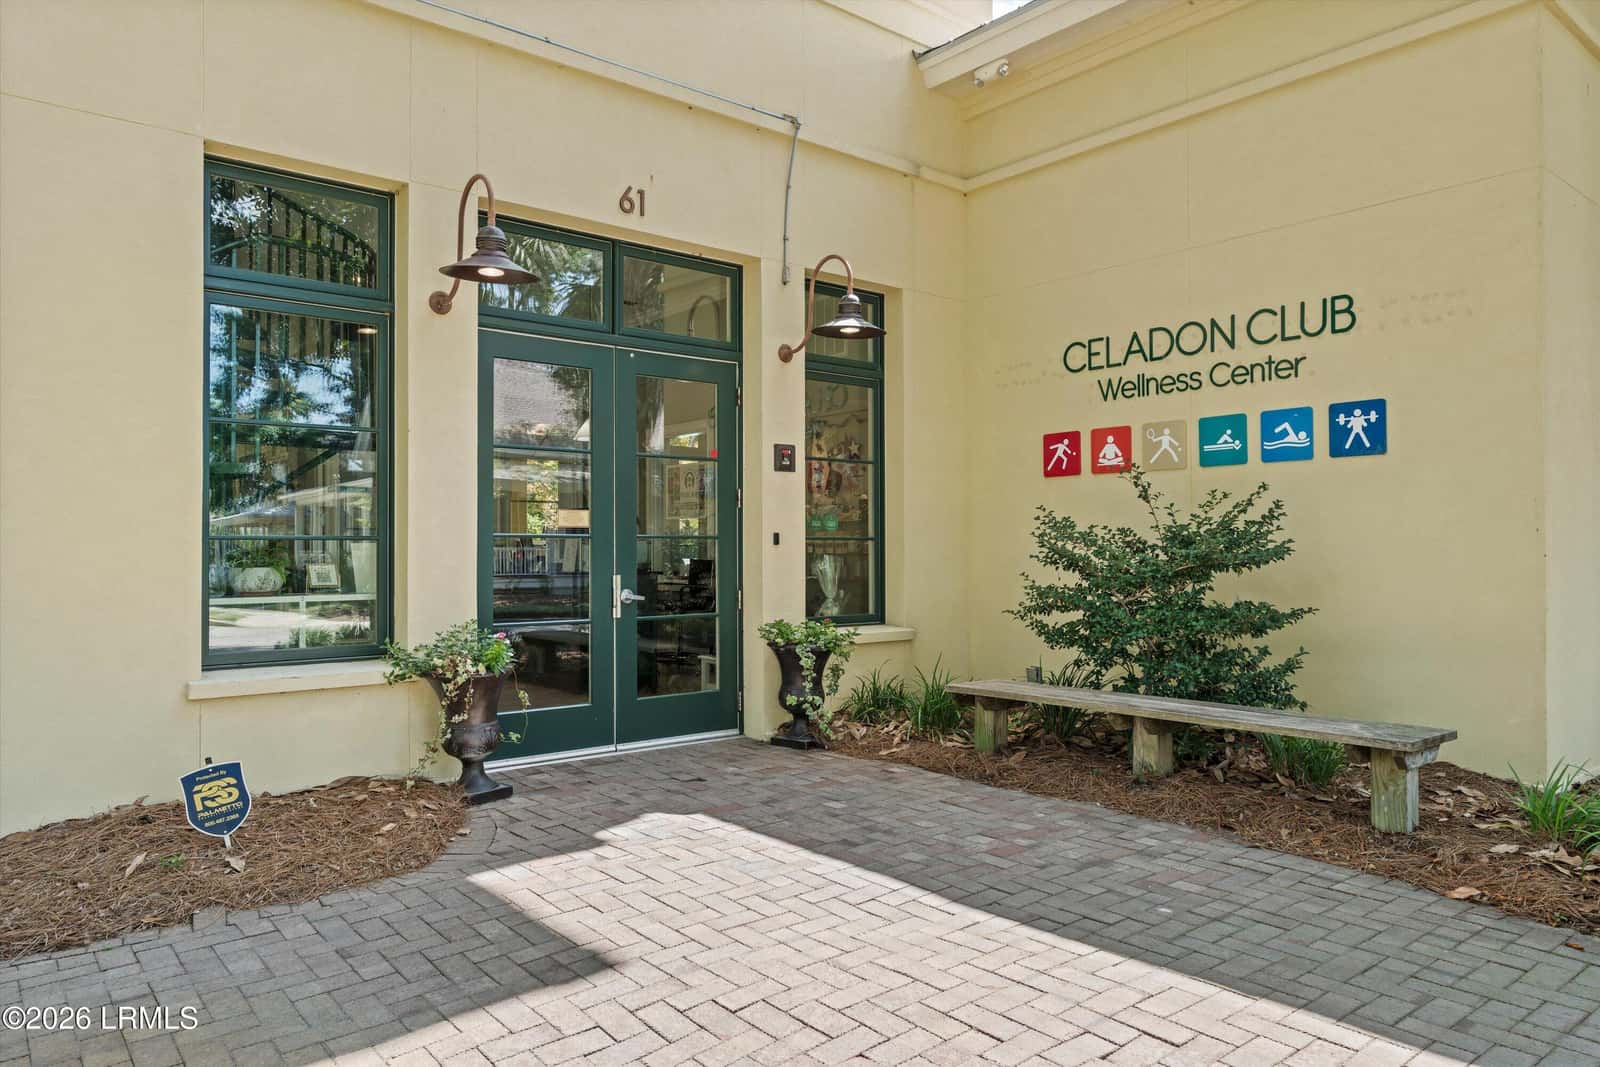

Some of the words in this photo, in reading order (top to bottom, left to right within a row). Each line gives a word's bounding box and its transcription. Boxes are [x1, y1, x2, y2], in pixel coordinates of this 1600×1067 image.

[618, 185, 646, 217] 61
[1062, 313, 1236, 374] CELADON
[1246, 294, 1357, 345] CLUB
[1097, 371, 1203, 402] Wellness
[1209, 355, 1307, 387] Center
[197, 801, 243, 819] PALMETTO
